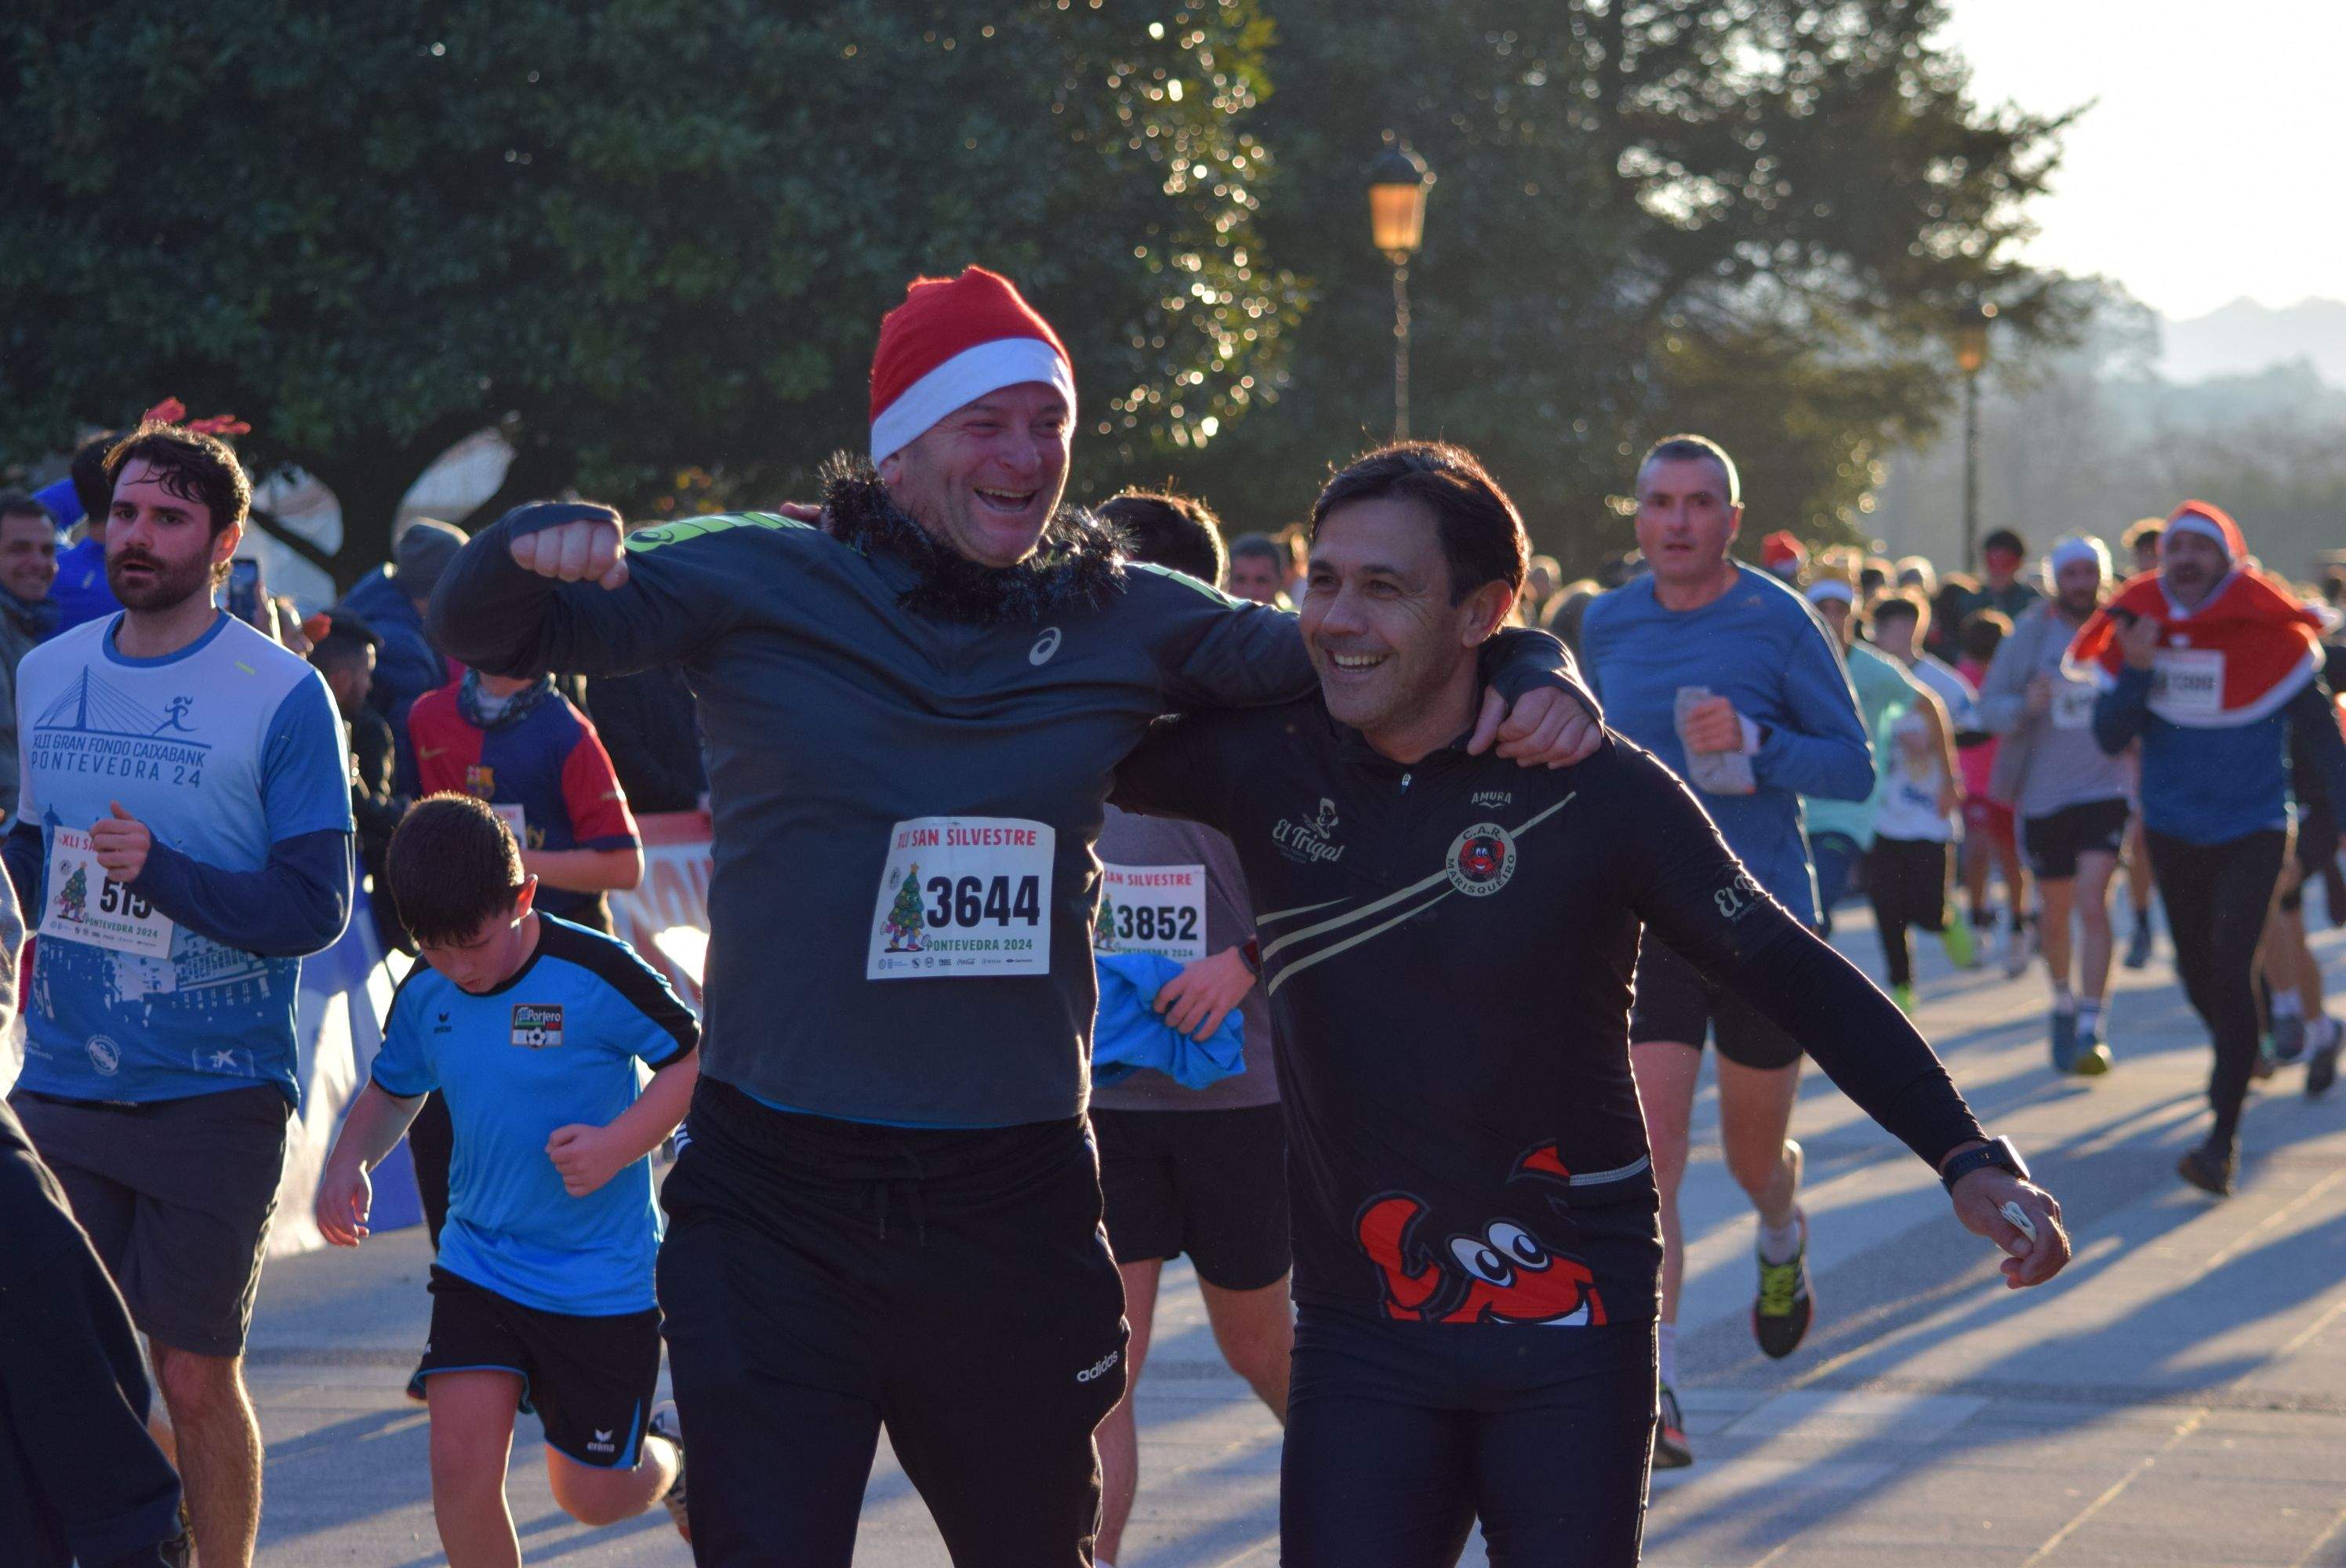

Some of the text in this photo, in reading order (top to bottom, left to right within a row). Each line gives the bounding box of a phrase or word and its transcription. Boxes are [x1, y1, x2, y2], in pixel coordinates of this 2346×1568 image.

[53, 734, 86, 751] GRAN
[88, 737, 131, 756] FONDO
[133, 742, 205, 768] CAIXABANK
[31, 751, 201, 788] PONTEVEDRA 24
[1471, 791, 1512, 804] AMURA
[62, 834, 79, 848] XLI
[912, 829, 939, 847] SAN
[946, 828, 1037, 847] SILVESTRE
[1272, 818, 1292, 842] El
[1292, 826, 1346, 862] Trigal
[1128, 873, 1193, 887] SILVESTRE
[1447, 855, 1515, 895] MARISQUEIRO
[926, 875, 1040, 928] 3644
[85, 916, 134, 934] PONTEVEDRA
[136, 927, 158, 938] 2024
[1117, 904, 1198, 941] 3852
[926, 938, 1033, 952] PONTEVEDRA 2024
[528, 1008, 562, 1023] Portero
[1077, 1350, 1118, 1382] adidas
